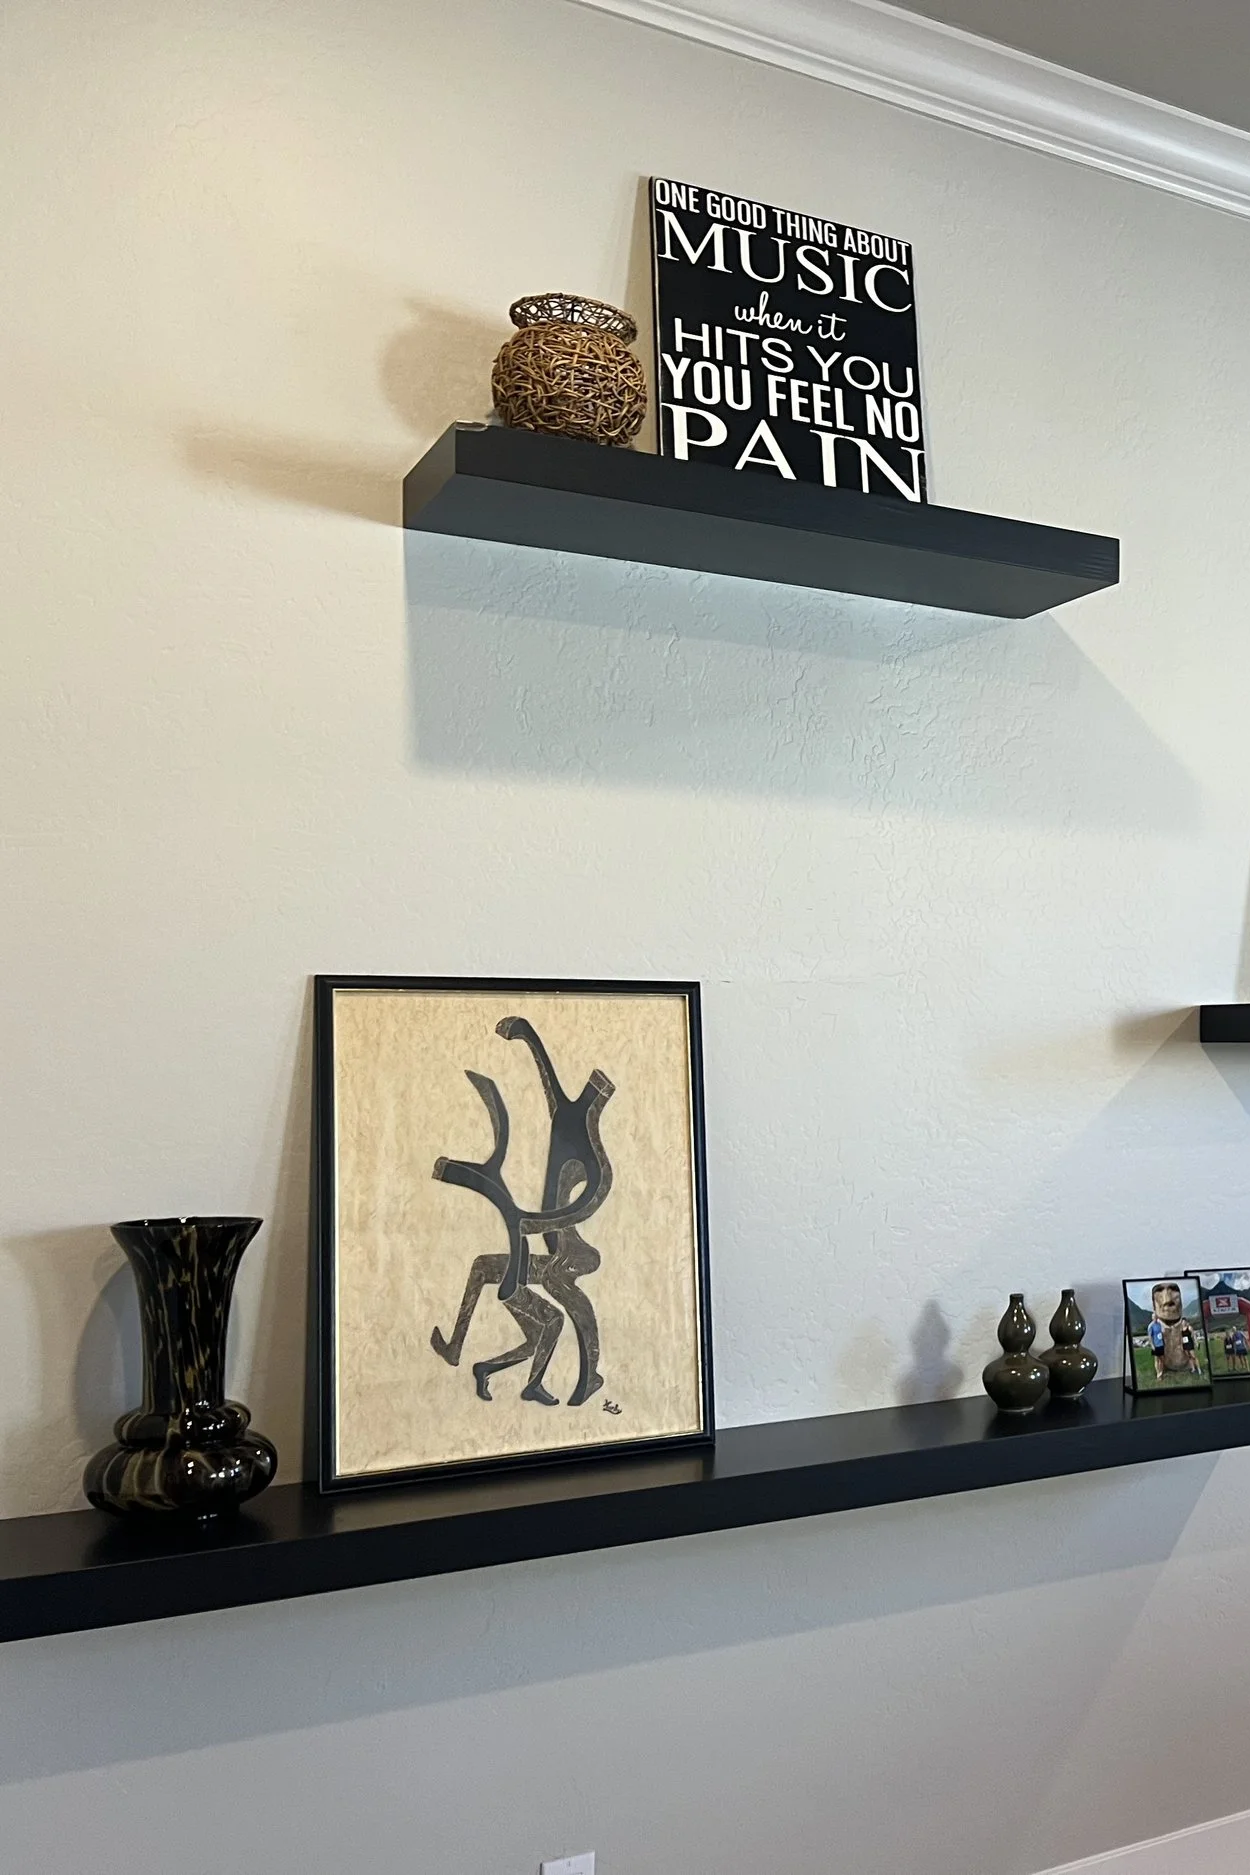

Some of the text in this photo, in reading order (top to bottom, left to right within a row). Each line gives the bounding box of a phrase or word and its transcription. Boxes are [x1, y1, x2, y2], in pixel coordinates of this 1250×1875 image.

[655, 179, 910, 266] ONE GOOD THING ABOUT
[656, 208, 912, 312] MUSIC
[674, 317, 914, 398] HITS YOU
[734, 291, 846, 341] when it
[661, 353, 920, 443] YOU FEEL NO
[660, 403, 925, 503] PAIN
